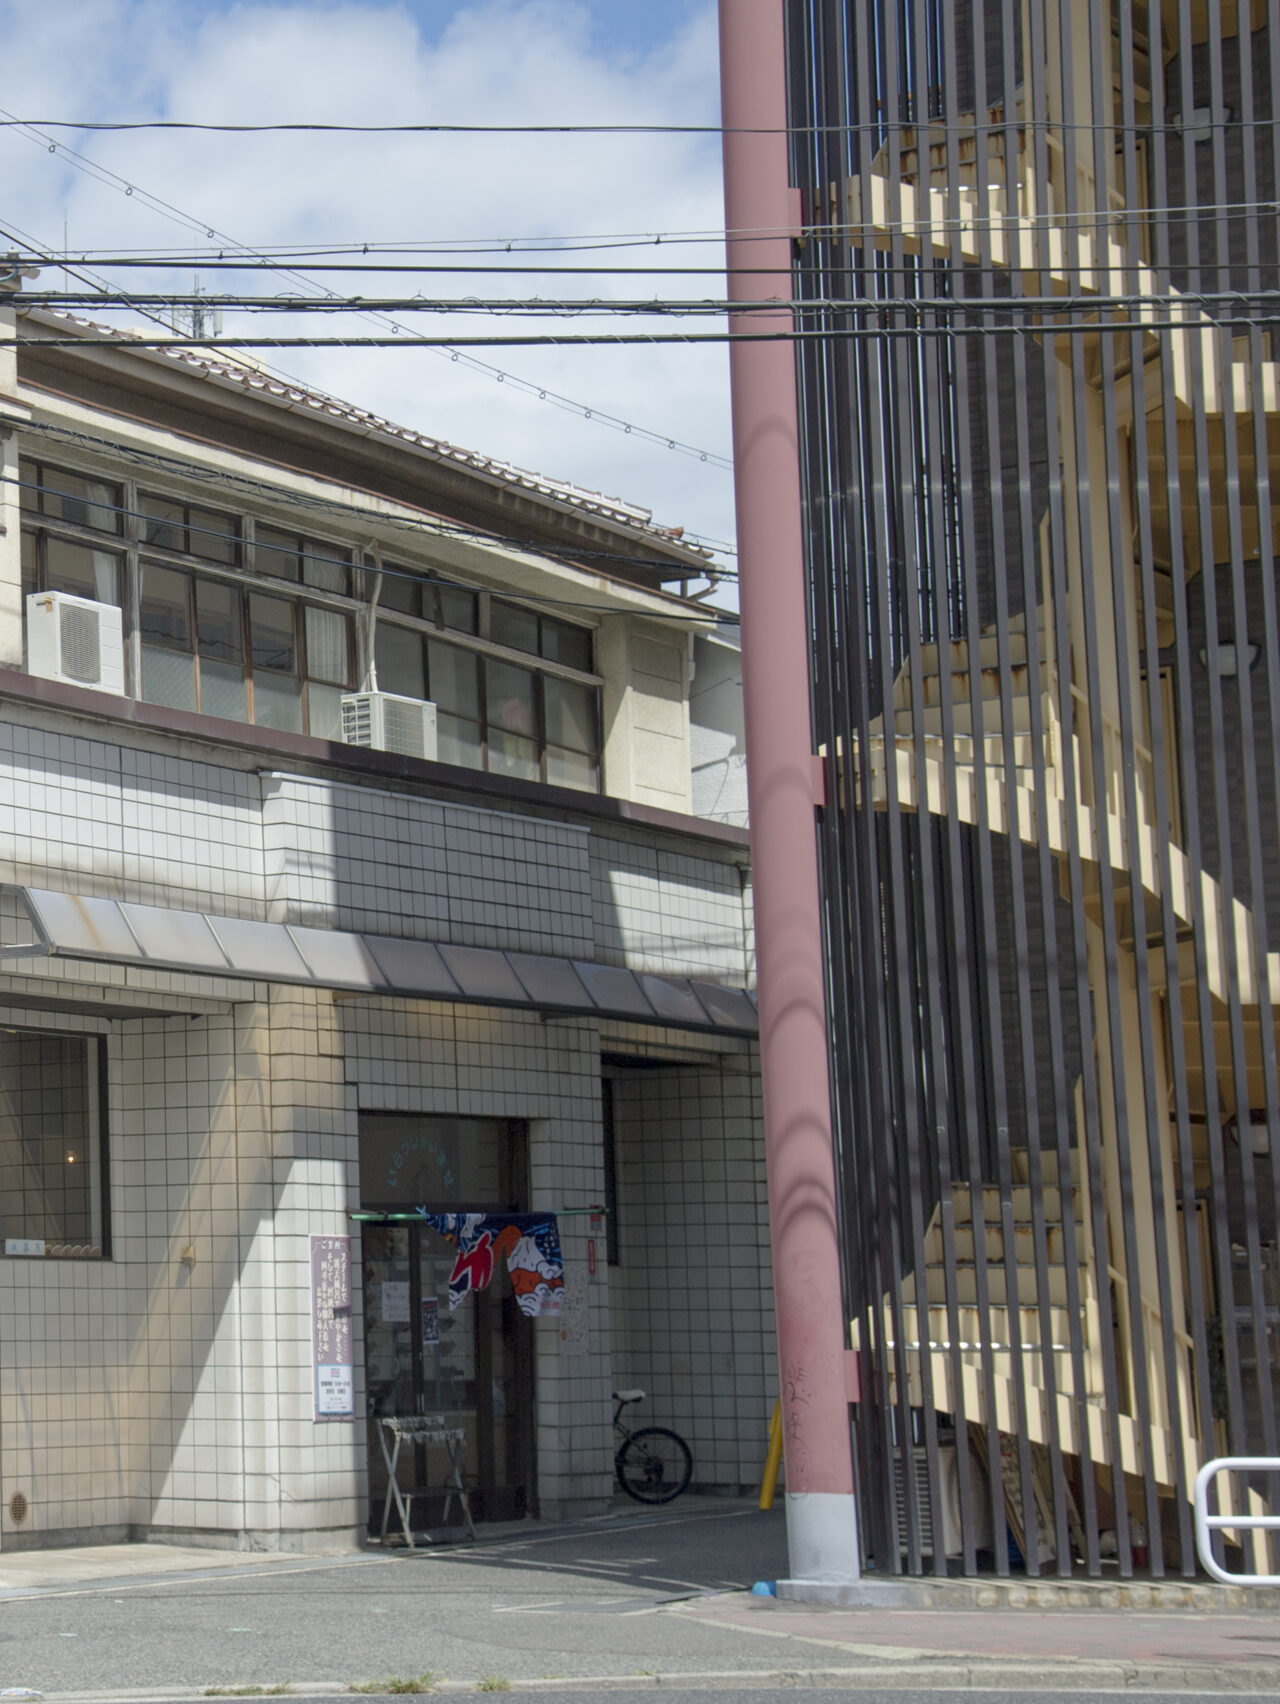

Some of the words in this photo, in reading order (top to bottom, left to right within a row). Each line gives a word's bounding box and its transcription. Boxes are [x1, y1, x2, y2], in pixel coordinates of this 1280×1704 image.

[386, 1136, 454, 1188] いらっしゃいませ
